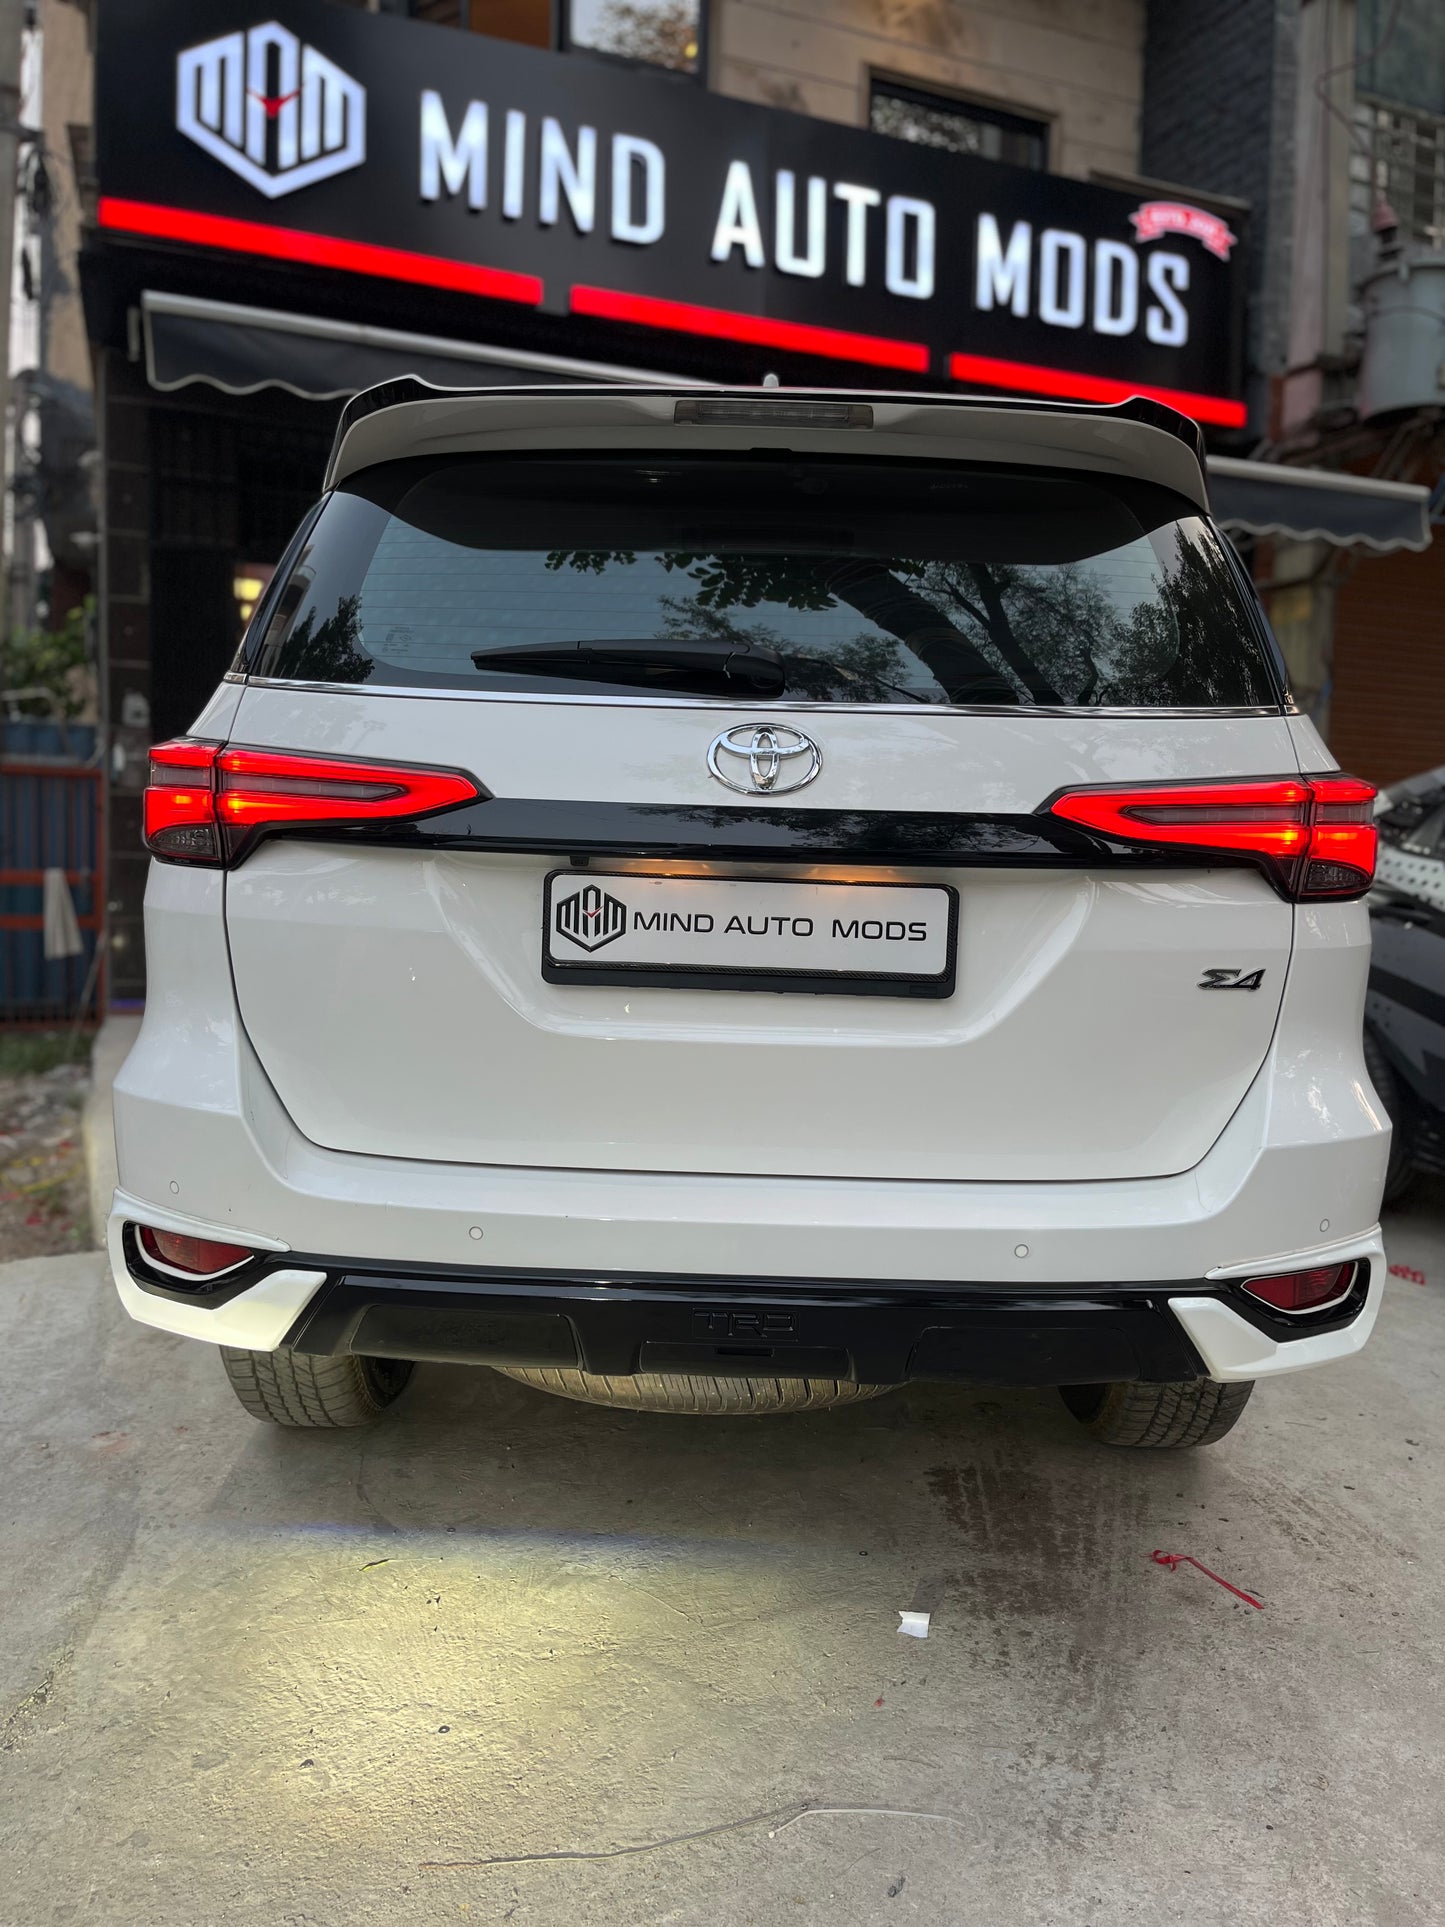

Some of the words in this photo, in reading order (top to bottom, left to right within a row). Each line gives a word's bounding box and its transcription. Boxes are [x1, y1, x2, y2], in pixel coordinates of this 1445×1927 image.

[420, 89, 666, 245] MIND
[711, 160, 936, 299] AUTO
[976, 213, 1190, 347] MODS
[633, 911, 714, 933] MIND
[723, 915, 814, 937] AUTO
[832, 919, 927, 942] MODS
[693, 1311, 797, 1338] TRD
